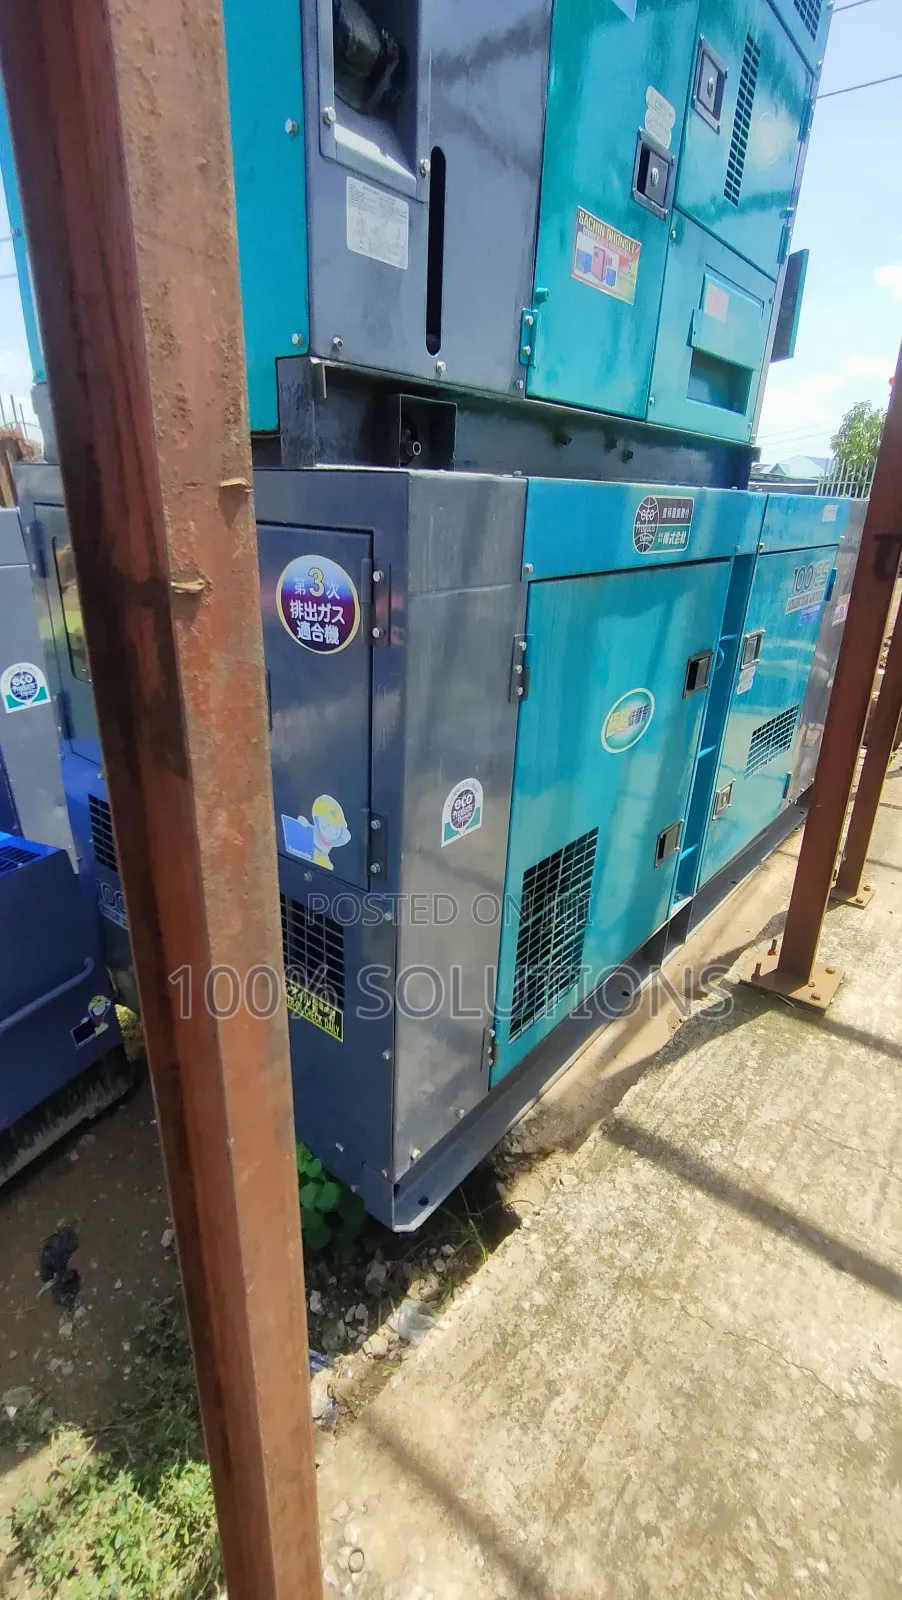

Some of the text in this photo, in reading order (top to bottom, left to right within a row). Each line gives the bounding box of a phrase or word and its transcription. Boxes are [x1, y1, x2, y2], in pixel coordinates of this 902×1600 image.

[579, 210, 605, 237] SACHIN
[640, 509, 655, 521] eco
[294, 568, 340, 599] 第3次
[289, 598, 346, 625] 排出ガス
[296, 620, 340, 646] 適合機
[12, 674, 33, 686] eco
[454, 793, 473, 810] eco
[324, 1017, 340, 1037] DAILY
